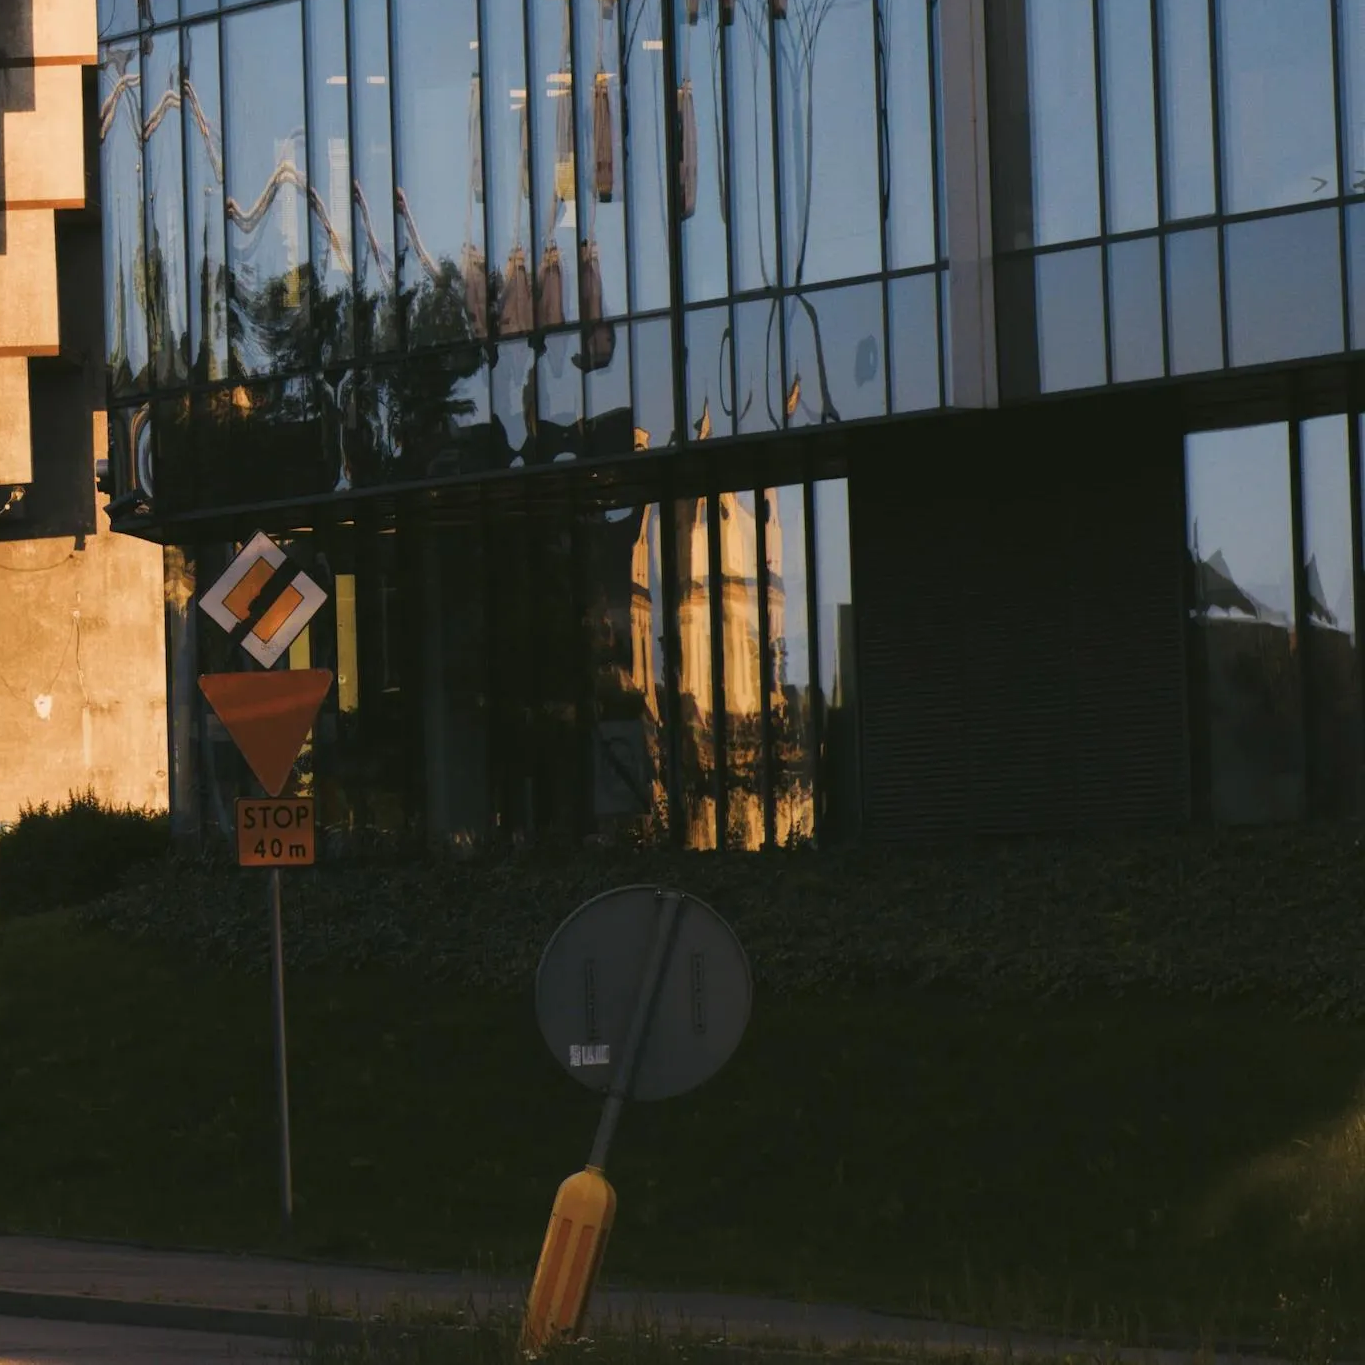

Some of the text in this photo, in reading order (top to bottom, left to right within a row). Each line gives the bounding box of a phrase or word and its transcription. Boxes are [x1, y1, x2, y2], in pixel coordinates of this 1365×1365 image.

[243, 805, 309, 830] STOP
[254, 838, 307, 858] 40 m
